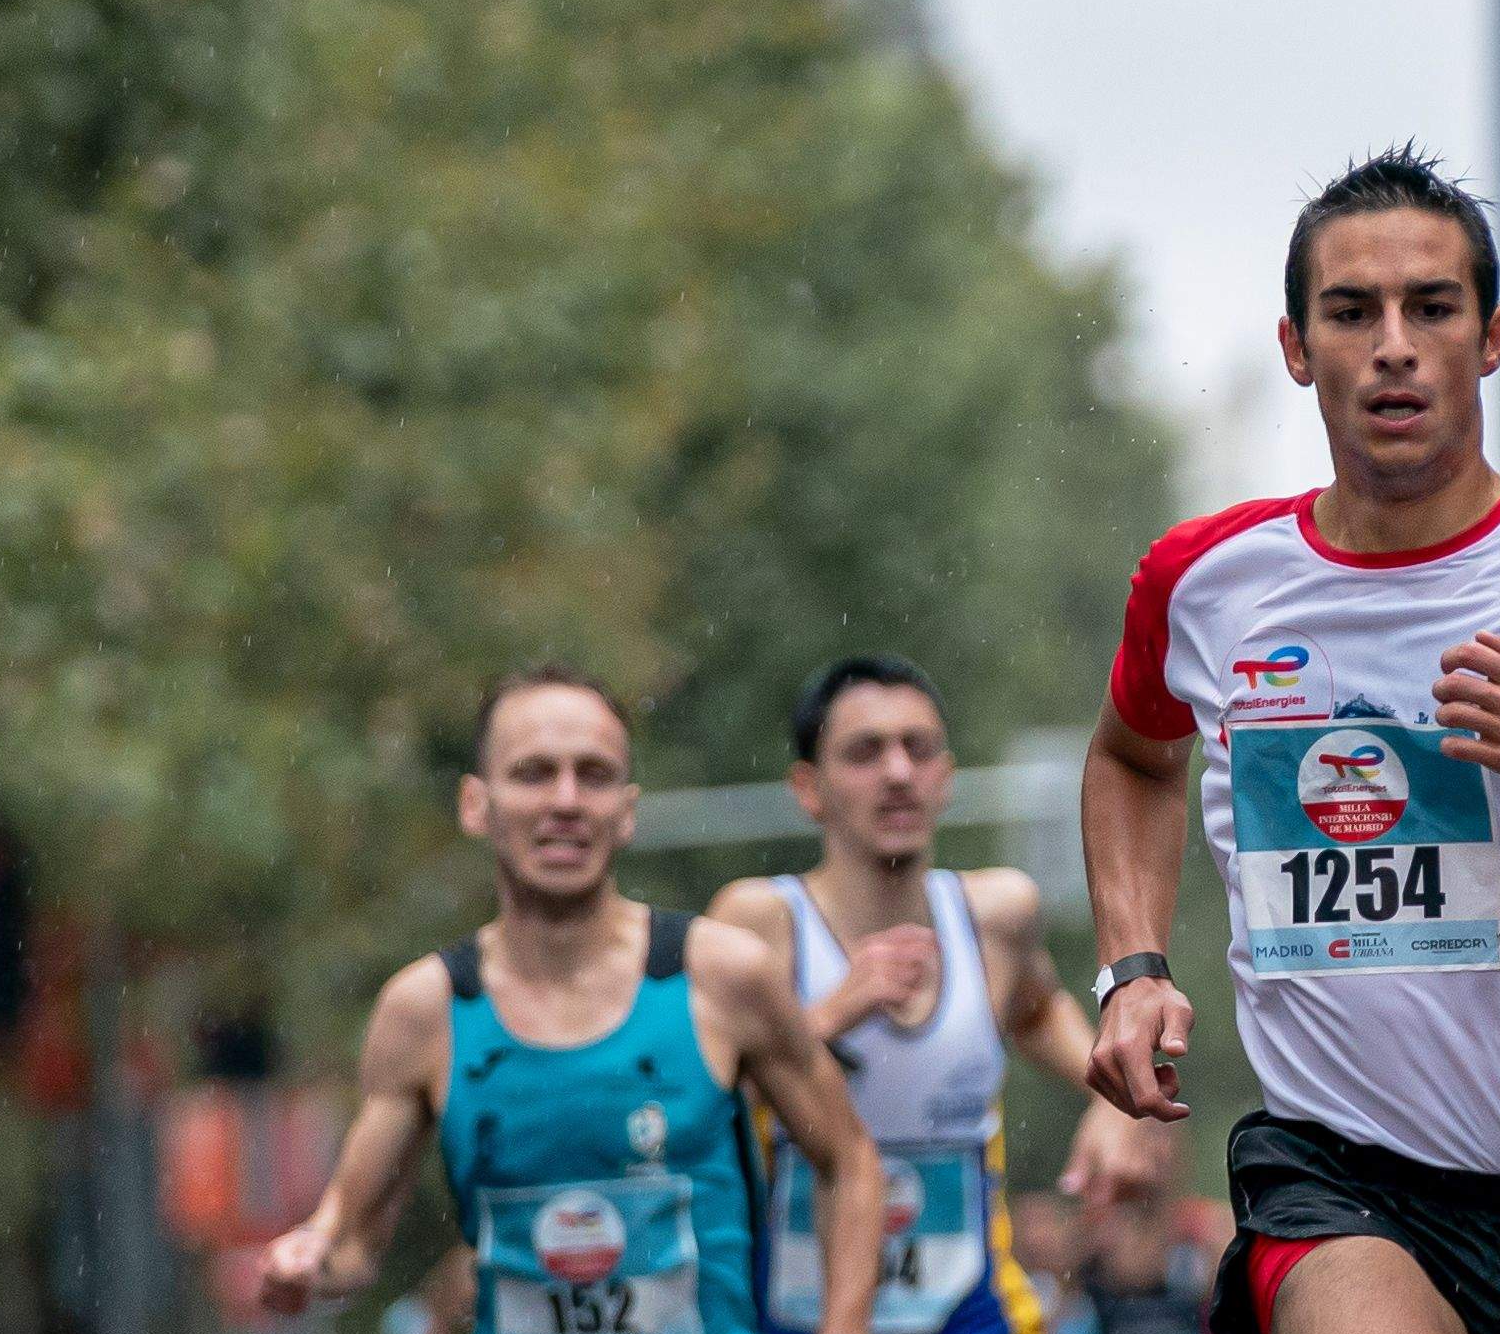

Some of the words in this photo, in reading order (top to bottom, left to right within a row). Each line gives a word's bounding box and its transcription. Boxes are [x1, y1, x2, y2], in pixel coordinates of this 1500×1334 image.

[1339, 803, 1371, 813] MILLA
[1329, 825, 1343, 834] DE
[1343, 823, 1384, 833] MADRID
[1280, 845, 1447, 925] 1254
[1352, 937, 1388, 947] MILLA
[1255, 943, 1314, 958] MADRID
